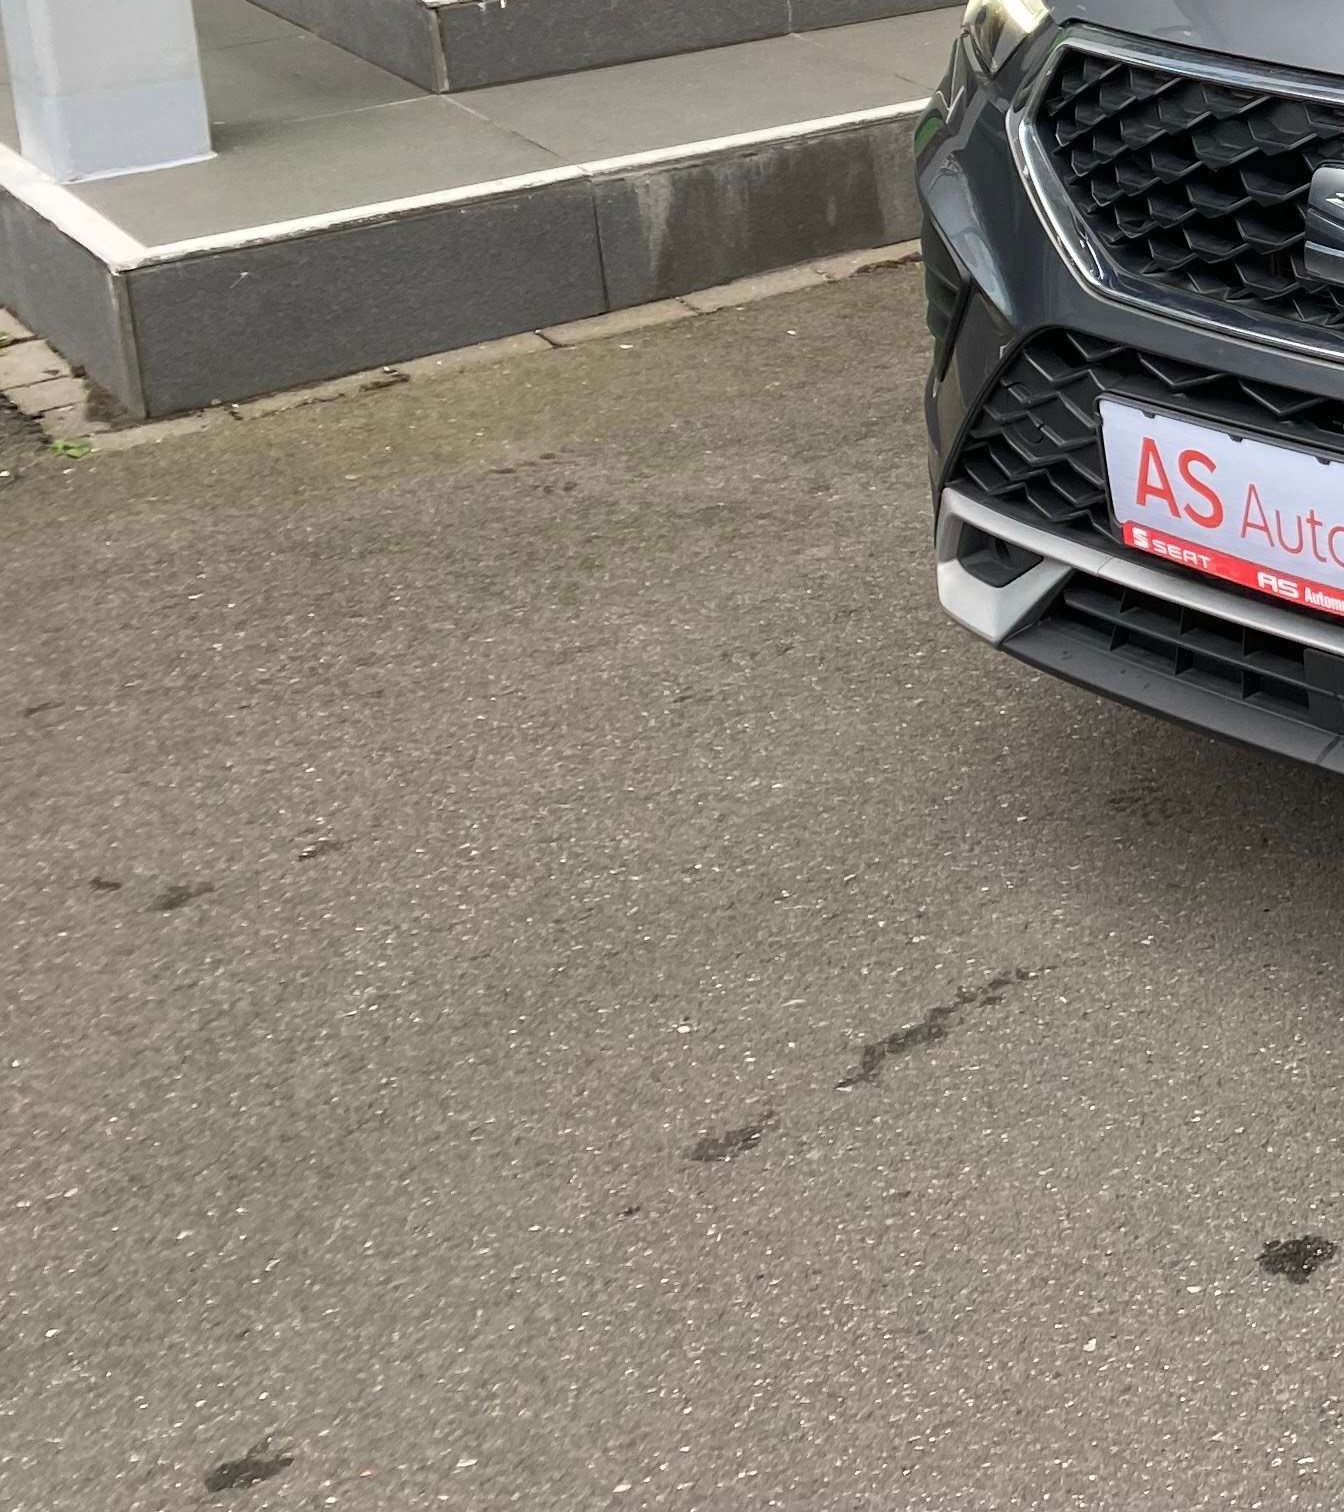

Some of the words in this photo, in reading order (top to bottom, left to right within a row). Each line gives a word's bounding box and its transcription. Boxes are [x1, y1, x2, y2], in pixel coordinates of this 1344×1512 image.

[1136, 435, 1224, 529] AS
[1151, 539, 1211, 569] SEAT
[1257, 572, 1299, 598] AS
